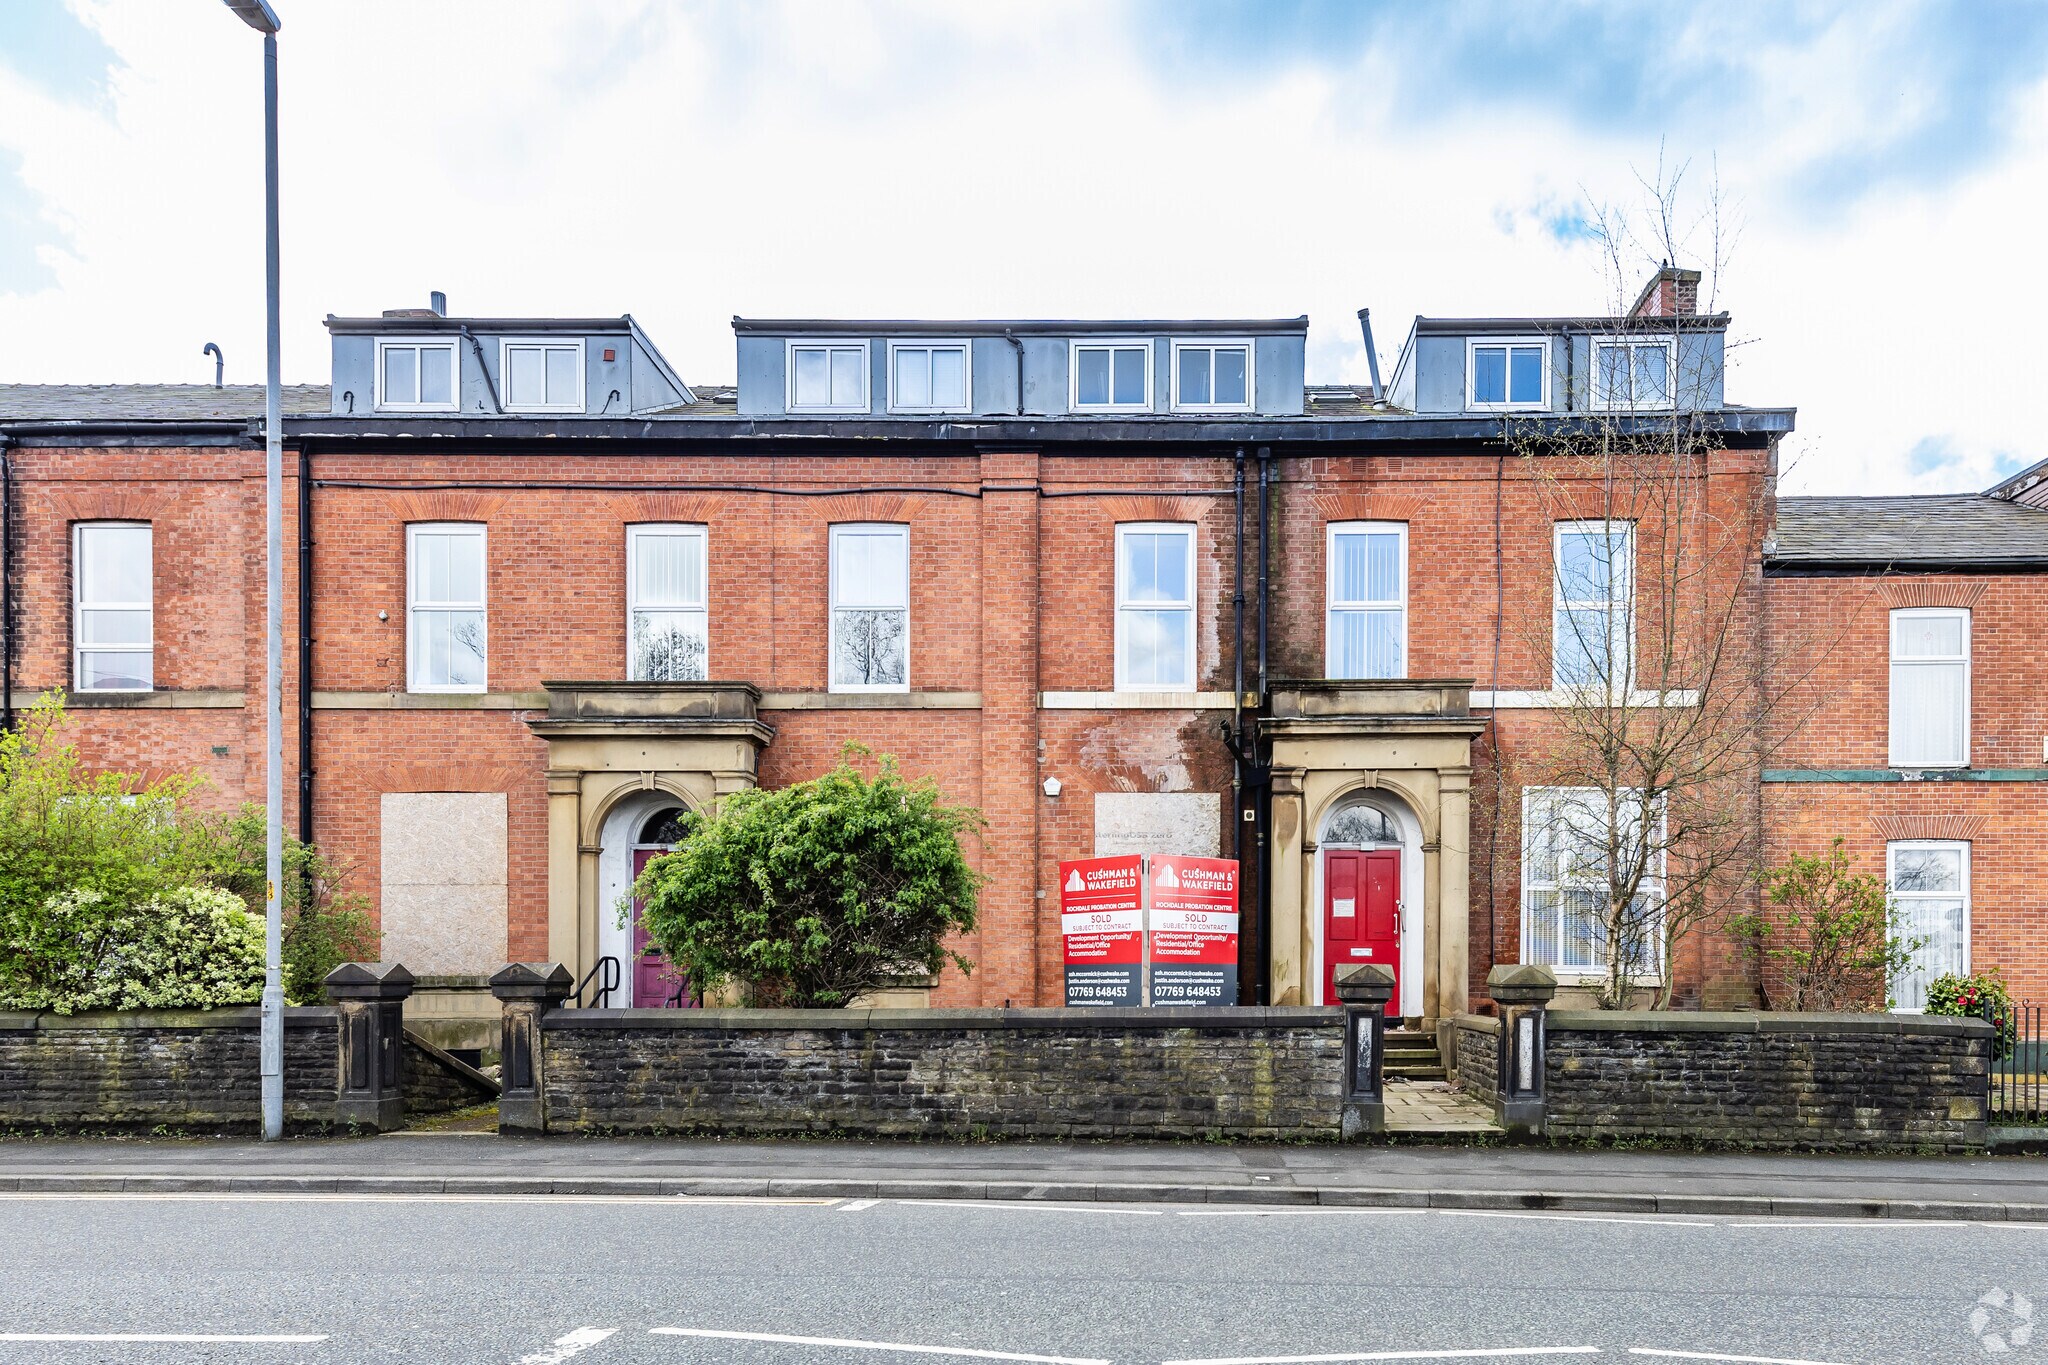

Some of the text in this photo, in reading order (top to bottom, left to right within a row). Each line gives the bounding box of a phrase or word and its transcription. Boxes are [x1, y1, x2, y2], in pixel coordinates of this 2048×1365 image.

[1087, 868, 1136, 880] CUSHMAN &
[1182, 869, 1233, 881] CUSHMAN &
[1087, 878, 1136, 890] WAKEFIELD
[1182, 880, 1233, 891] WAKEFIELD
[1091, 903, 1117, 911] PROBATION
[1213, 904, 1232, 912] CENTRE
[1091, 914, 1112, 924] SOLD
[1185, 913, 1208, 923] SOLD
[1072, 924, 1094, 932] SUBJECT
[1163, 922, 1188, 930] SUBJECT
[1198, 923, 1228, 931] CONTRACT
[1067, 932, 1133, 942] Development Opportunity/
[1155, 932, 1228, 942] Development Opportunity/
[1068, 941, 1111, 949] Residential/Office
[1155, 940, 1205, 948] Residential/Office
[1156, 948, 1201, 956] Accommodation
[1068, 986, 1127, 997] 07769 648453
[1154, 986, 1221, 997] 07769 648453
